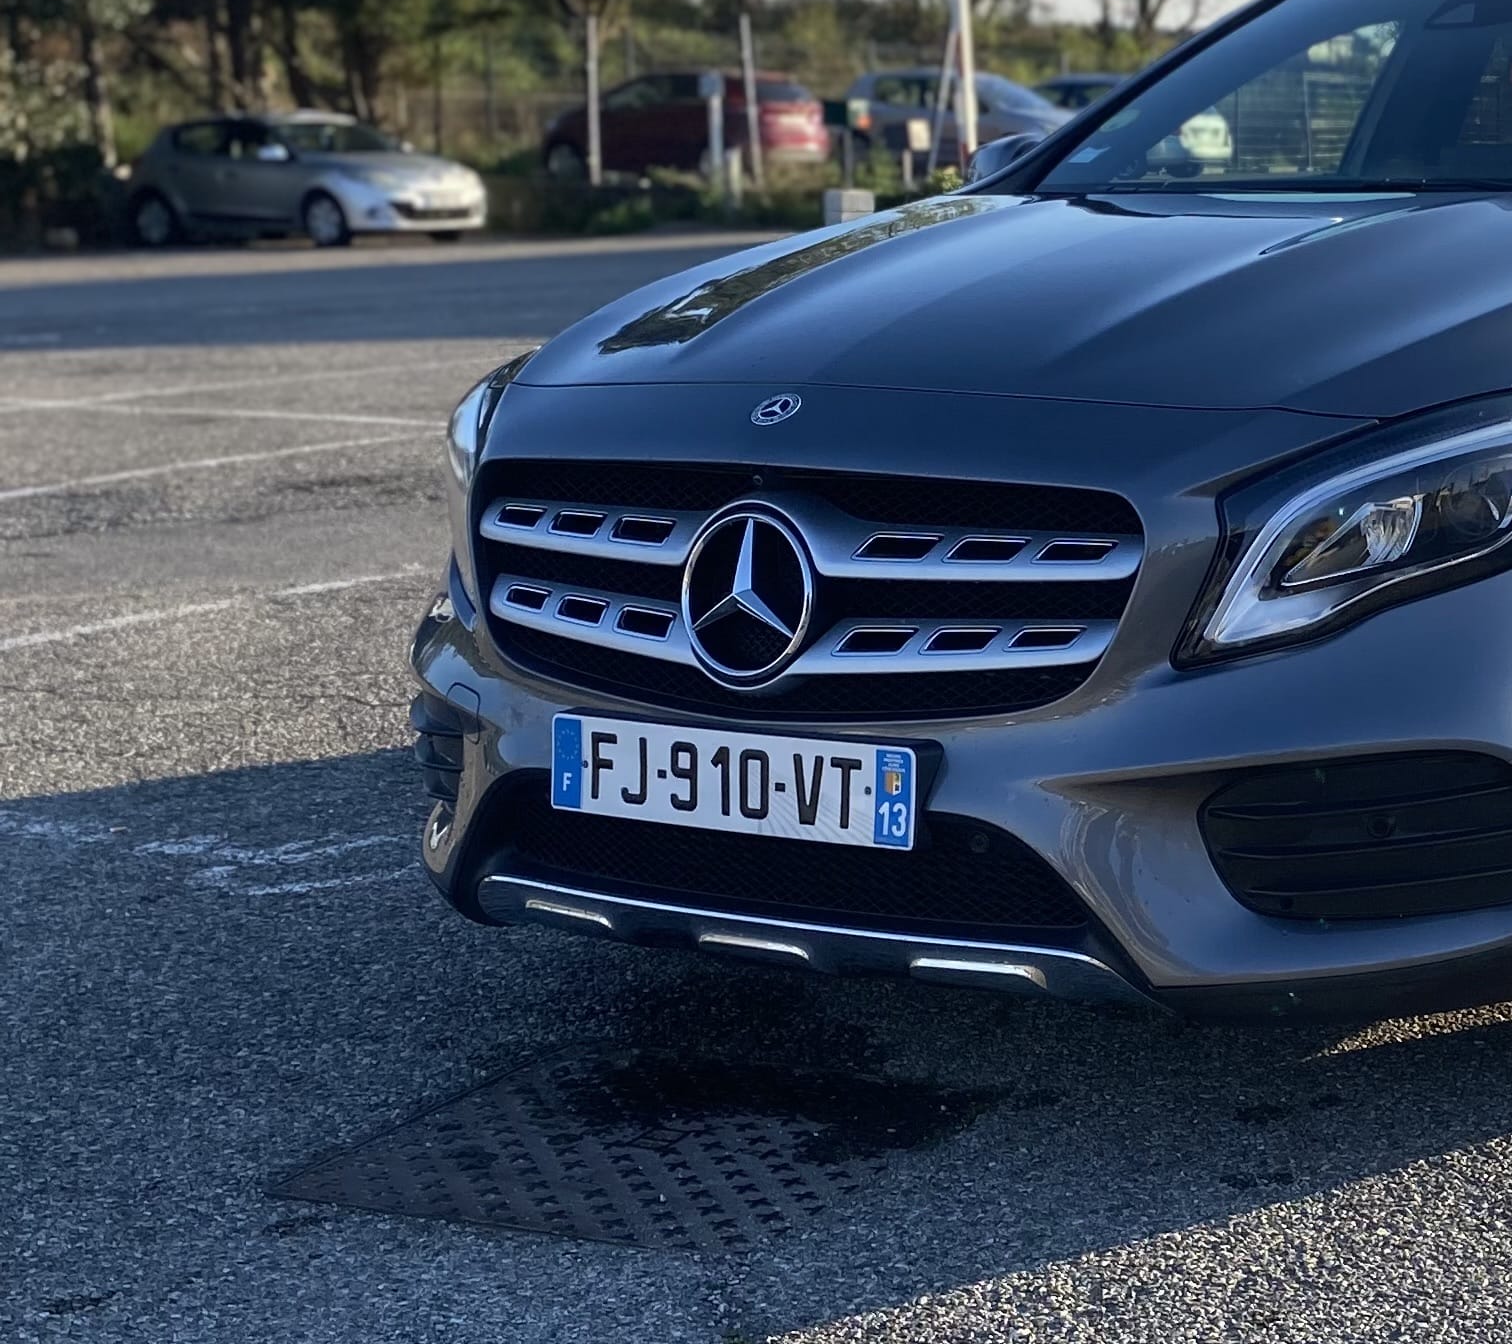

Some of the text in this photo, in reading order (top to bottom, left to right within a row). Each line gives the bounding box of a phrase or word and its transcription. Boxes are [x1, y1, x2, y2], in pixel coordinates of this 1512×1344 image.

[562, 772, 572, 792] F
[591, 731, 862, 829] FJ-910-VT
[878, 801, 907, 837] 13
